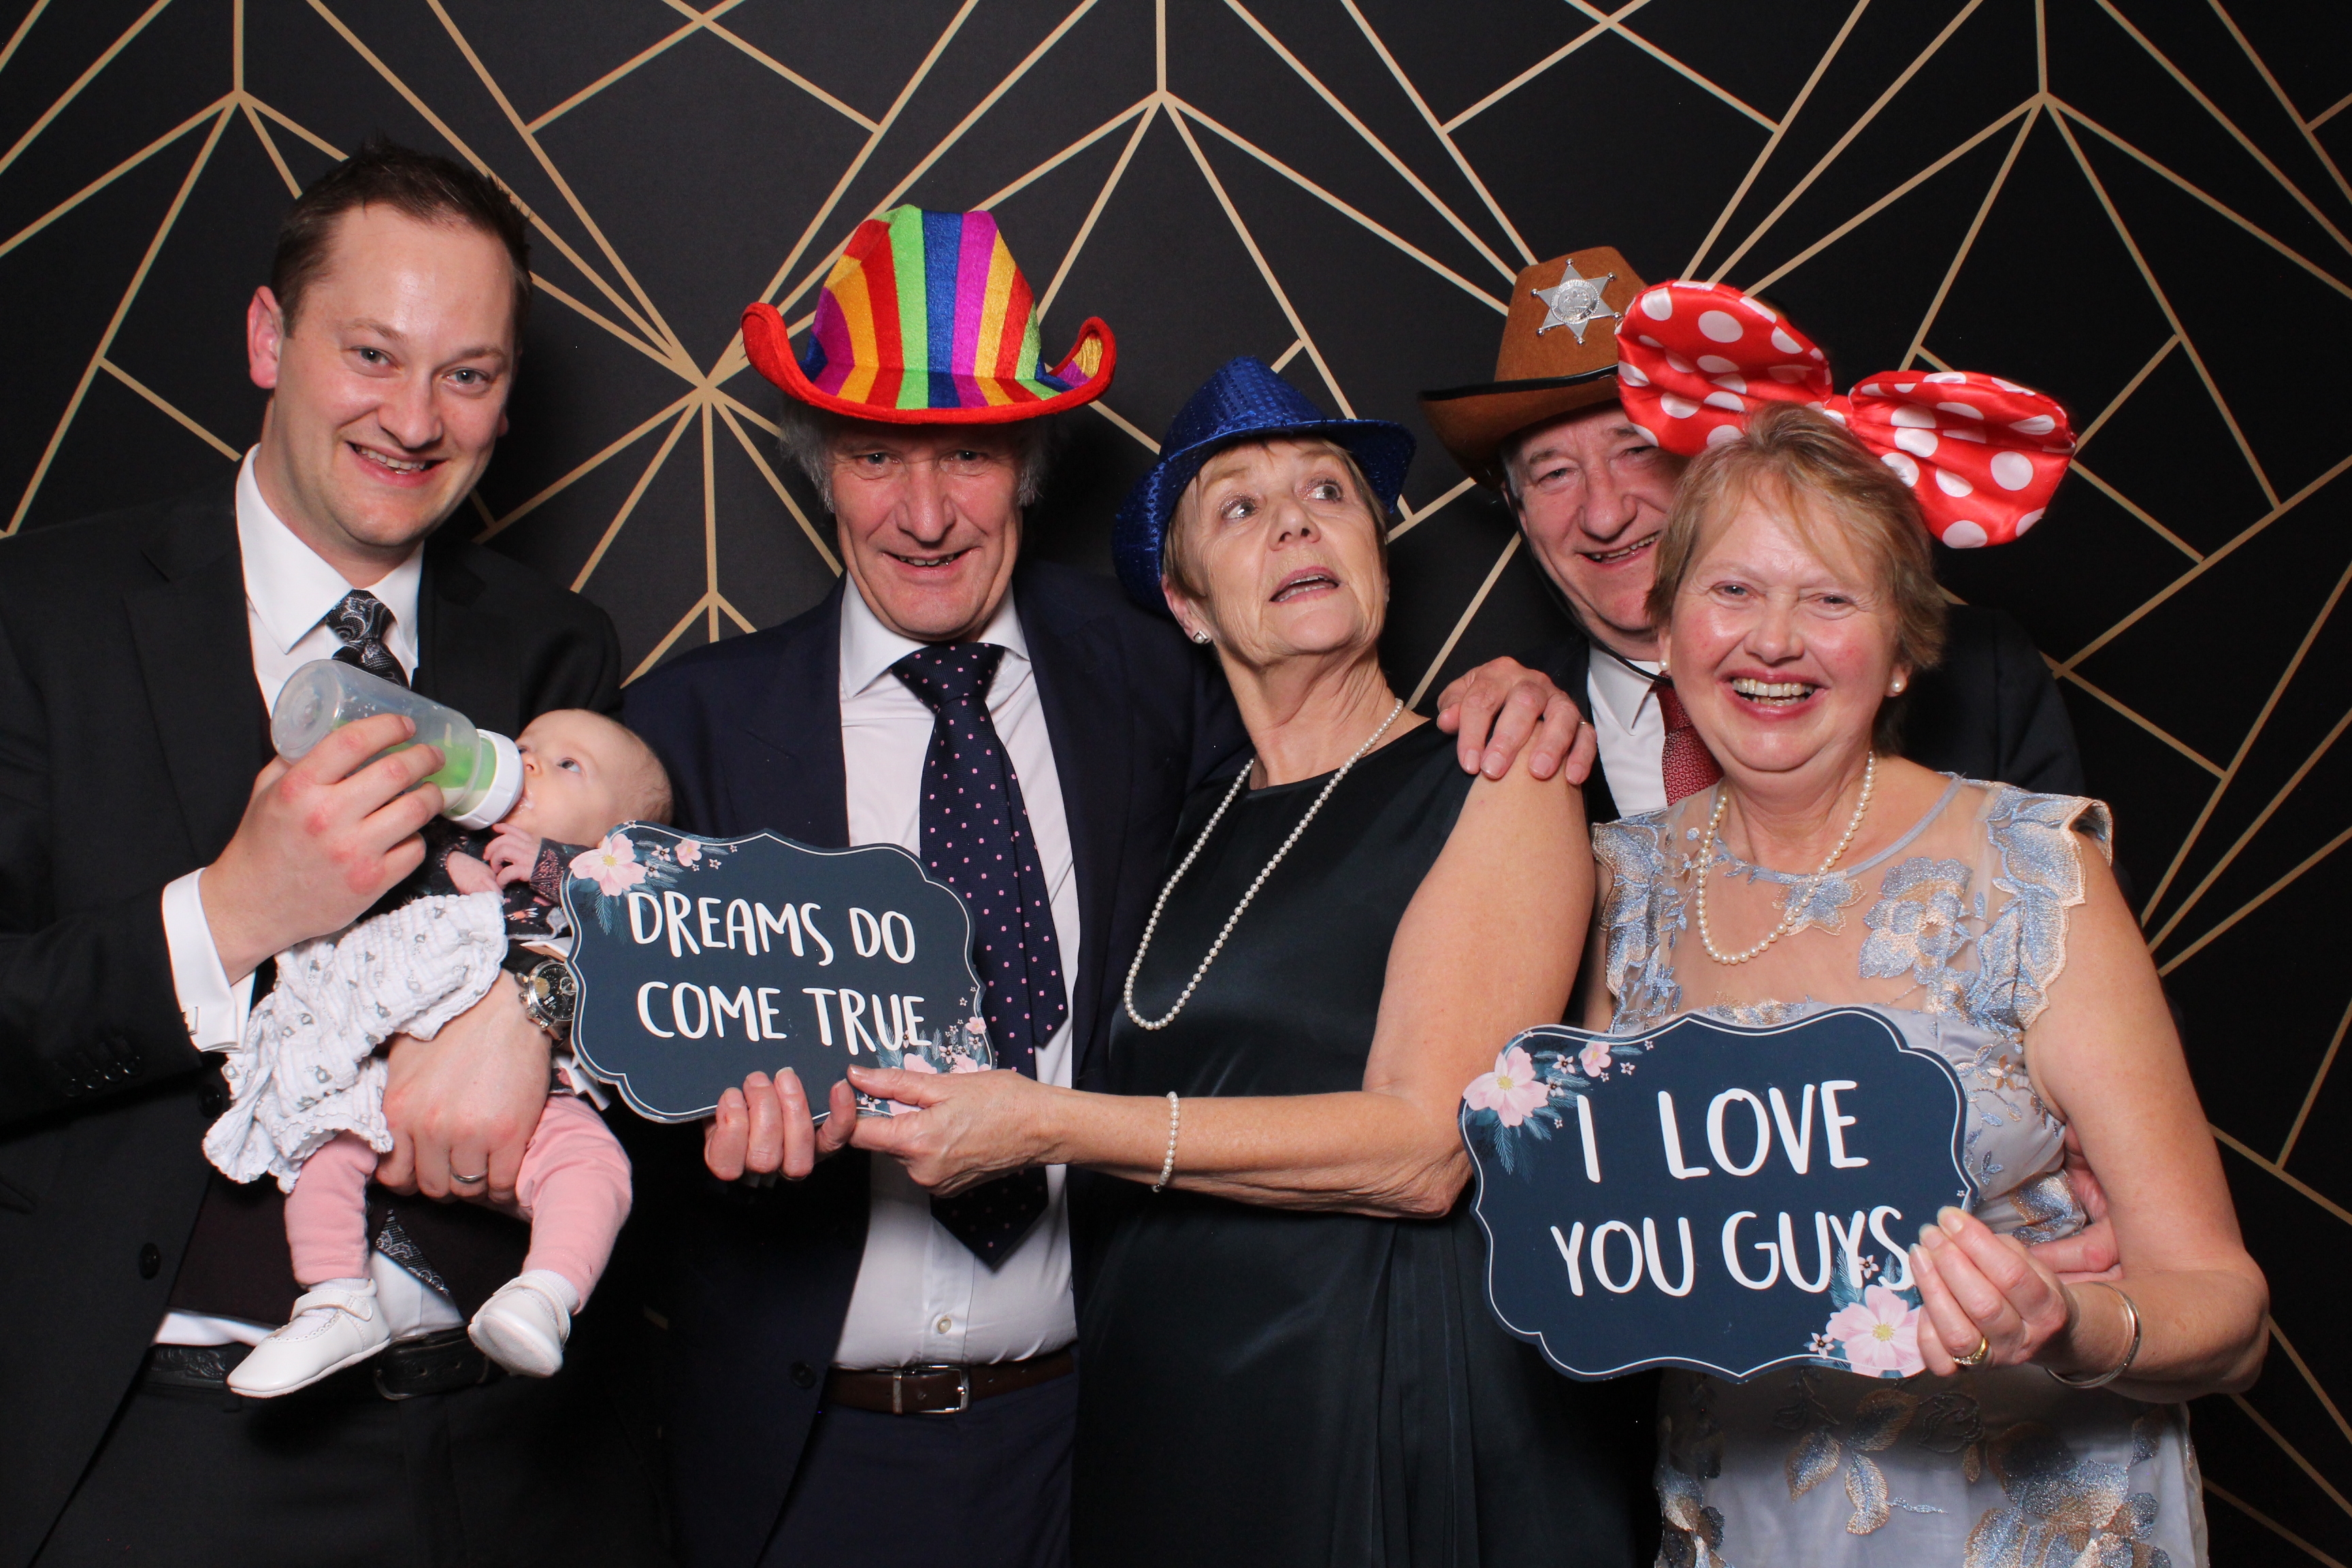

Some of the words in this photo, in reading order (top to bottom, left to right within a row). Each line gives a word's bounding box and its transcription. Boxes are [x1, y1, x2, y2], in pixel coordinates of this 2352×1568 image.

[629, 891, 834, 966] DREAMS
[849, 907, 915, 963] DO
[637, 981, 787, 1042] COME
[802, 987, 932, 1055] TRUE
[1576, 1094, 1601, 1183] I
[1658, 1080, 1869, 1179] LOVE
[1550, 1217, 1695, 1297] YOU
[1721, 1205, 1916, 1294] GUYS
